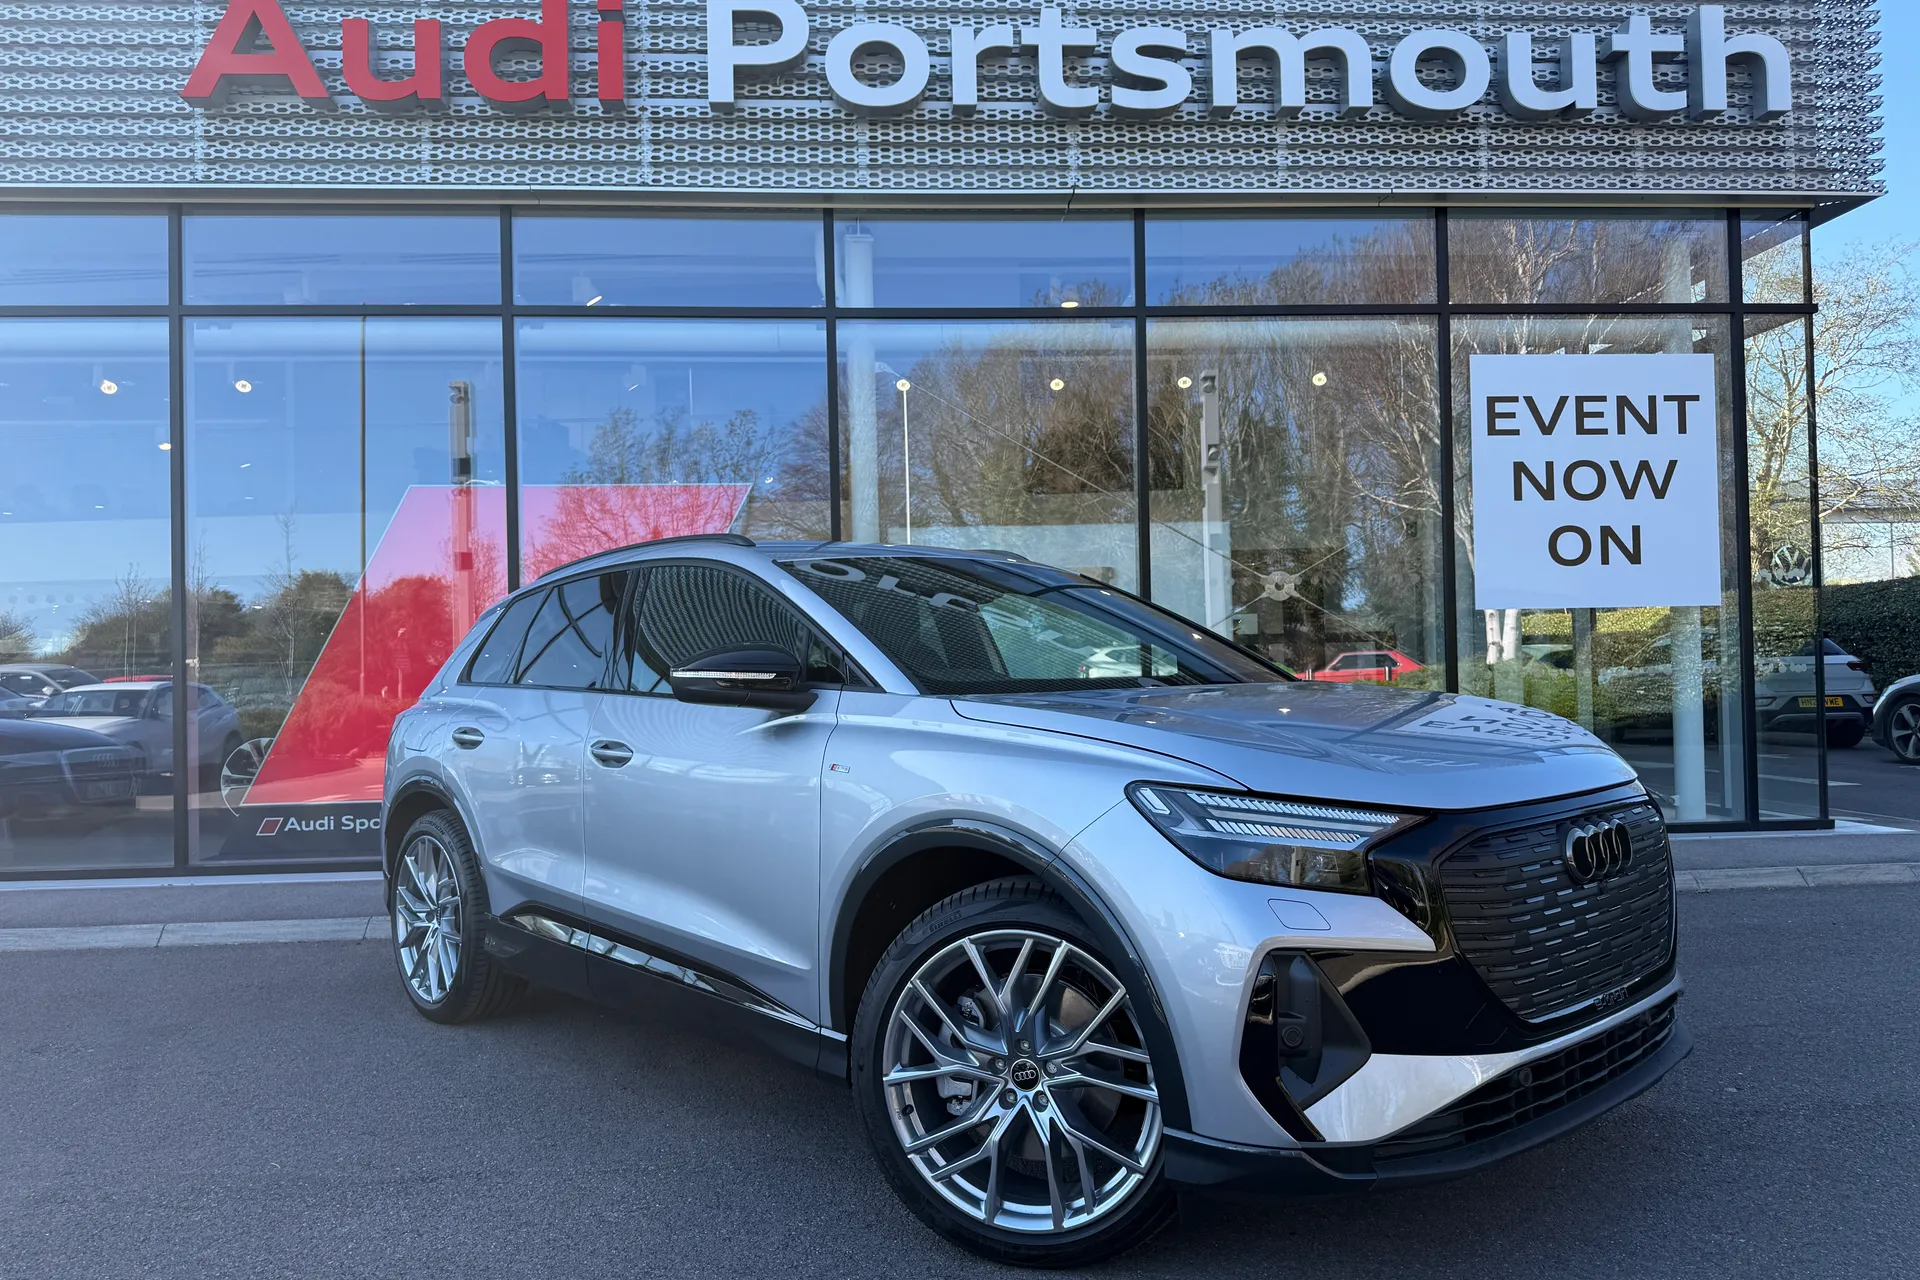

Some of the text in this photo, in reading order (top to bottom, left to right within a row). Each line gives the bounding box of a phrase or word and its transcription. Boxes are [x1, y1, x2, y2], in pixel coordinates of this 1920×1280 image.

[182, 0, 1793, 114] Audi Portsmouth
[1486, 395, 1700, 436] EVENT
[1512, 460, 1678, 502] NOW
[1548, 525, 1642, 567] ON
[283, 816, 334, 832] Audi
